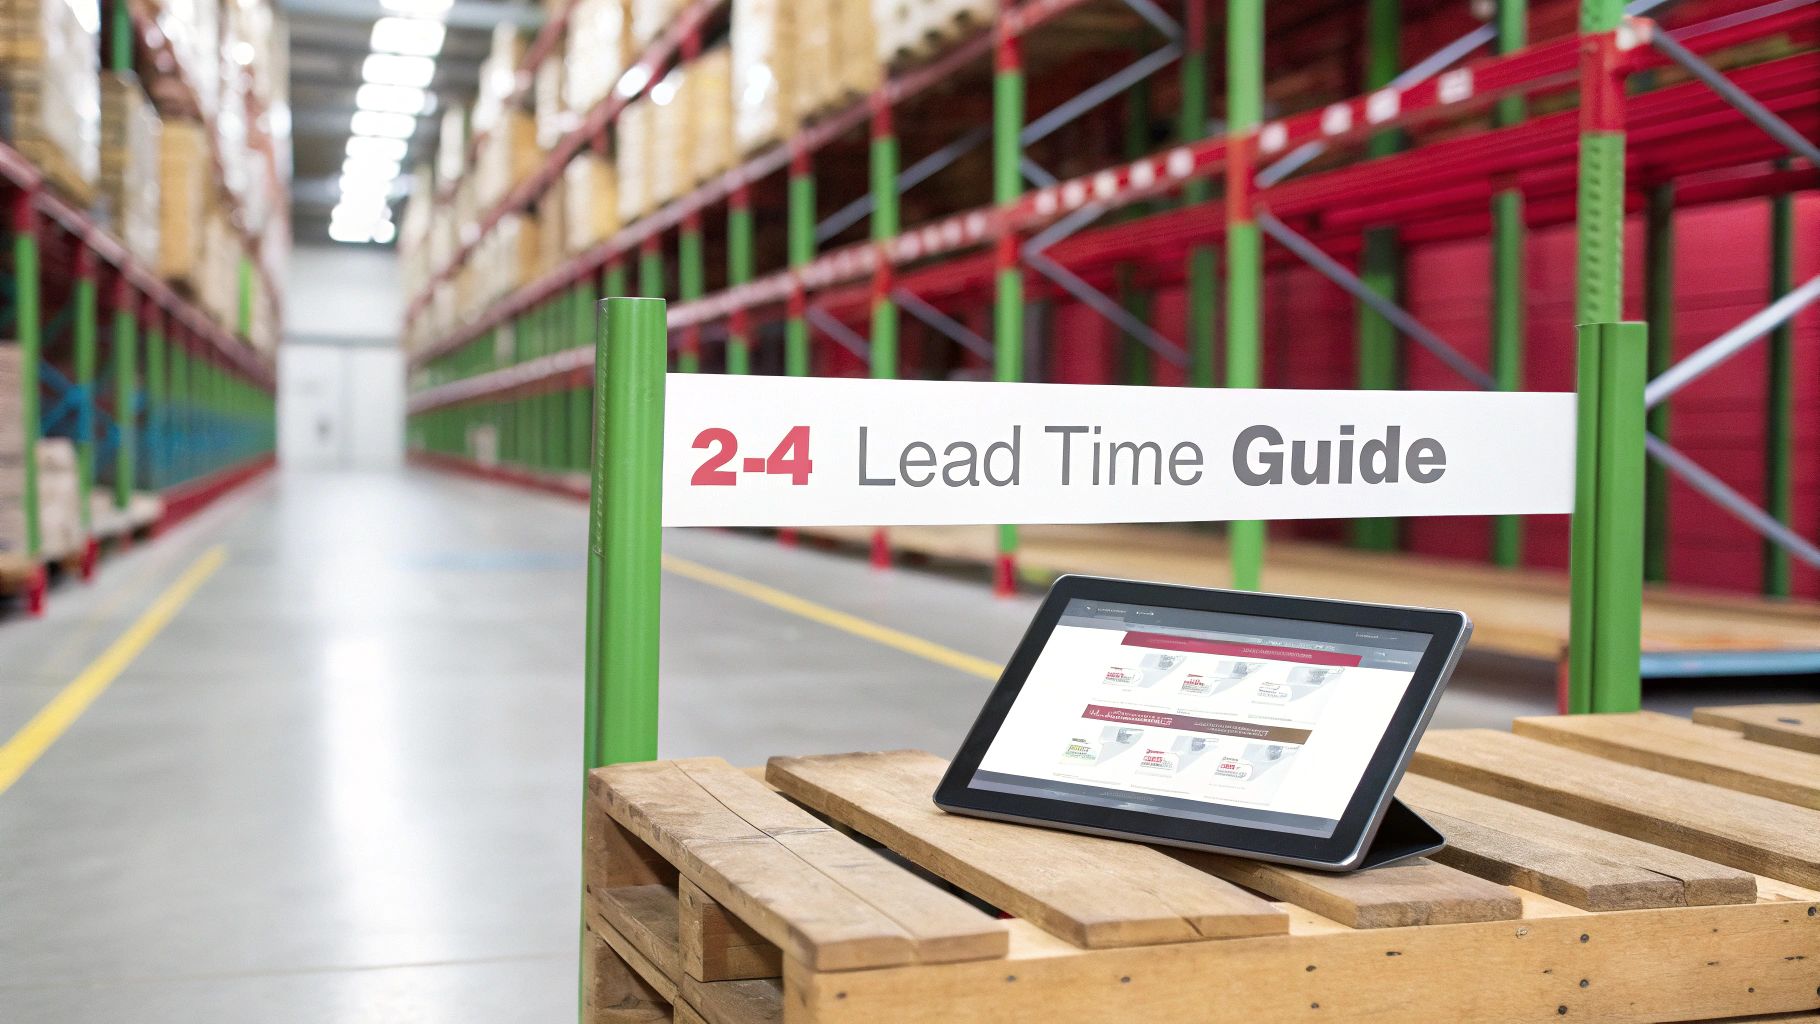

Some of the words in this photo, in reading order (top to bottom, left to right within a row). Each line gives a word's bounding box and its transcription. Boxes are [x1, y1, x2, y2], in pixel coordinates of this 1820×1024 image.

[691, 426, 812, 486] 2-4
[859, 425, 1021, 487] Lead
[1045, 426, 1203, 486] Time
[1232, 425, 1446, 485] Guide
